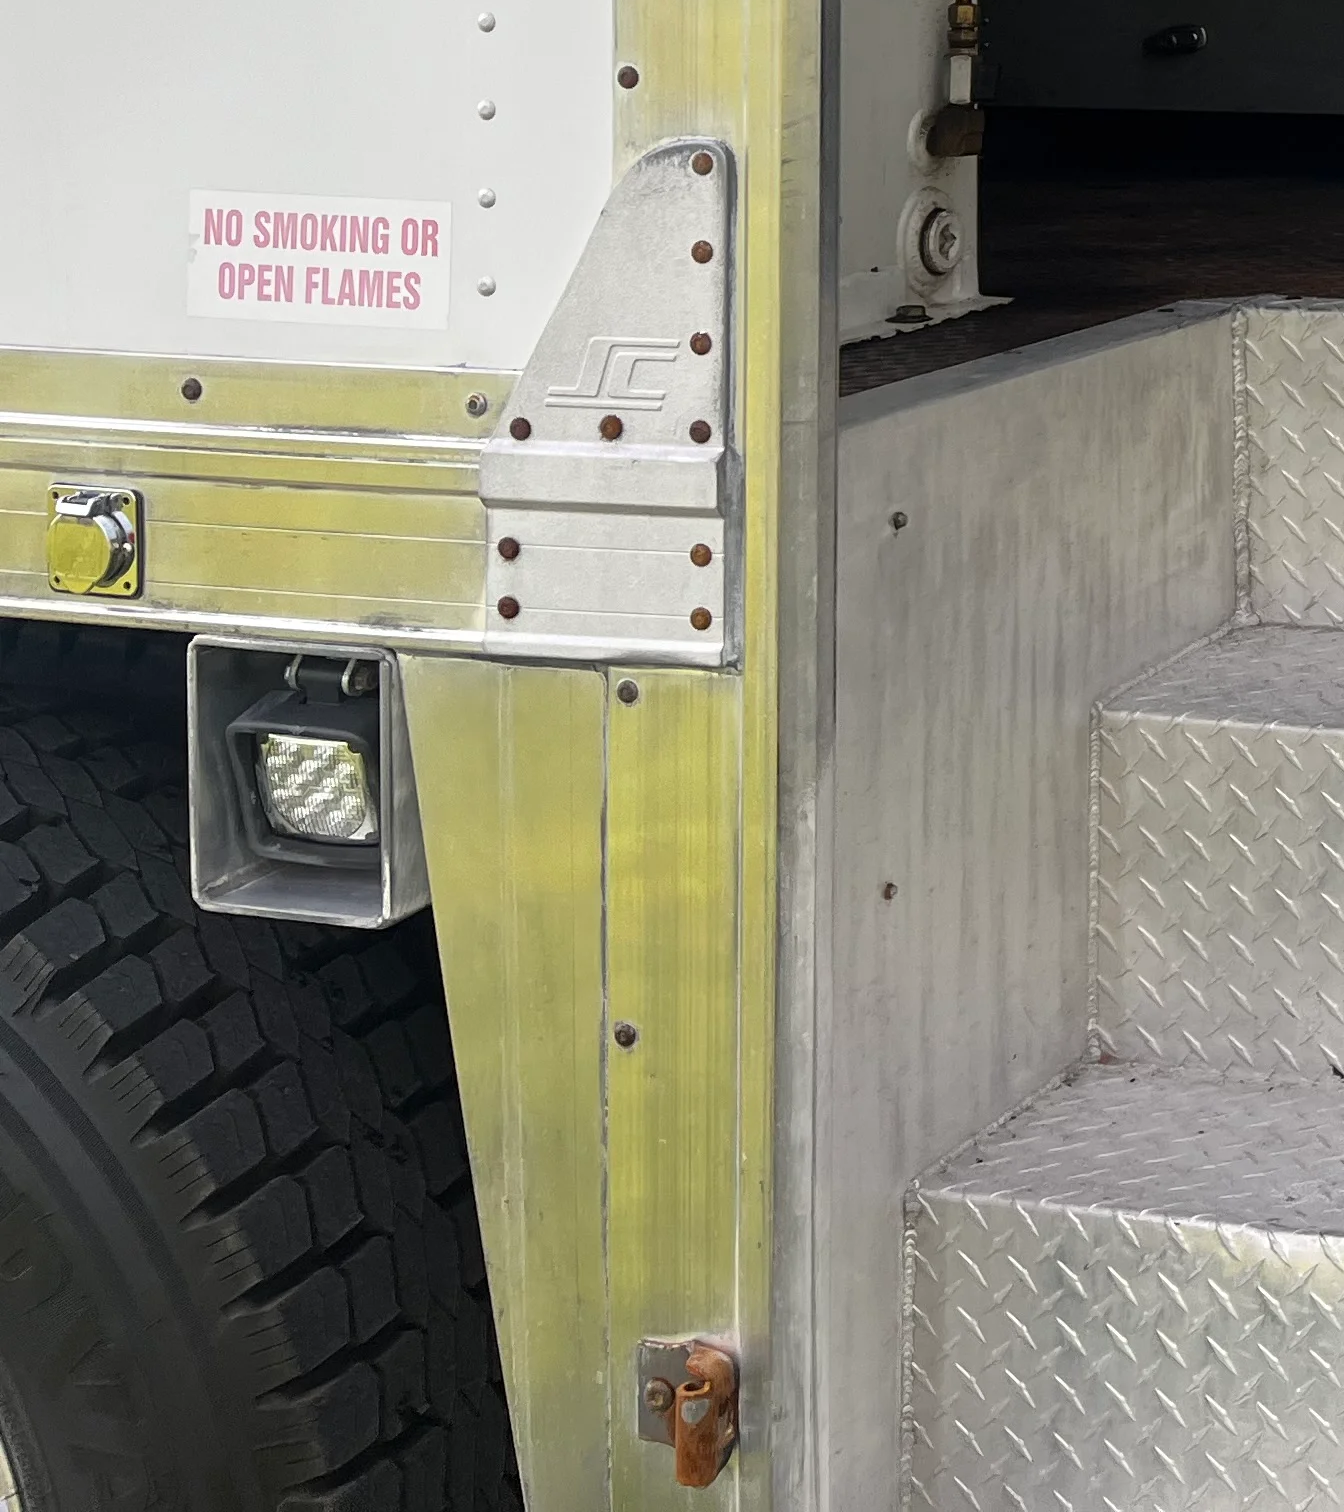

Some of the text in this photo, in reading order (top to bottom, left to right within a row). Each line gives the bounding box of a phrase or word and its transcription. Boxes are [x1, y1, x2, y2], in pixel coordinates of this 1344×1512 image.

[204, 208, 439, 258] NO SMOKING OR
[218, 261, 421, 311] OPEN FLAMES
